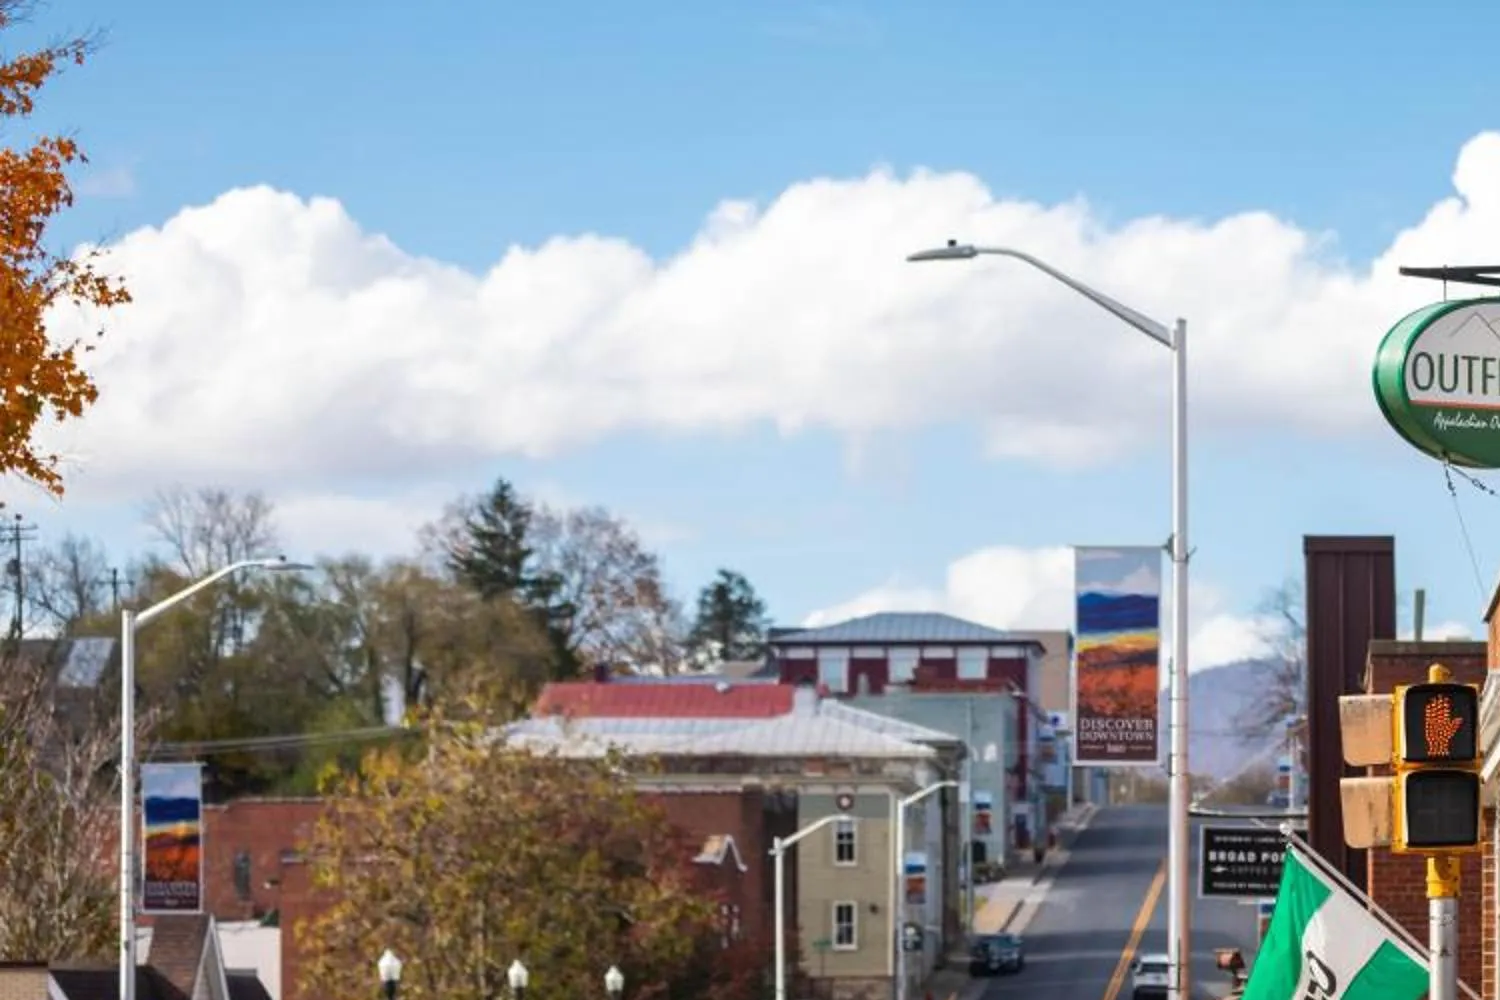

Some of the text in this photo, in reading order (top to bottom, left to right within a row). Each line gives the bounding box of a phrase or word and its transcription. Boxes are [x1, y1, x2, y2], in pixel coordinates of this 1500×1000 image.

[1433, 411, 1488, 431] Appalachian
[1080, 719, 1153, 730] DISCOVER
[1079, 731, 1154, 741] DOWNTOWN
[1208, 850, 1257, 863] BROAD
